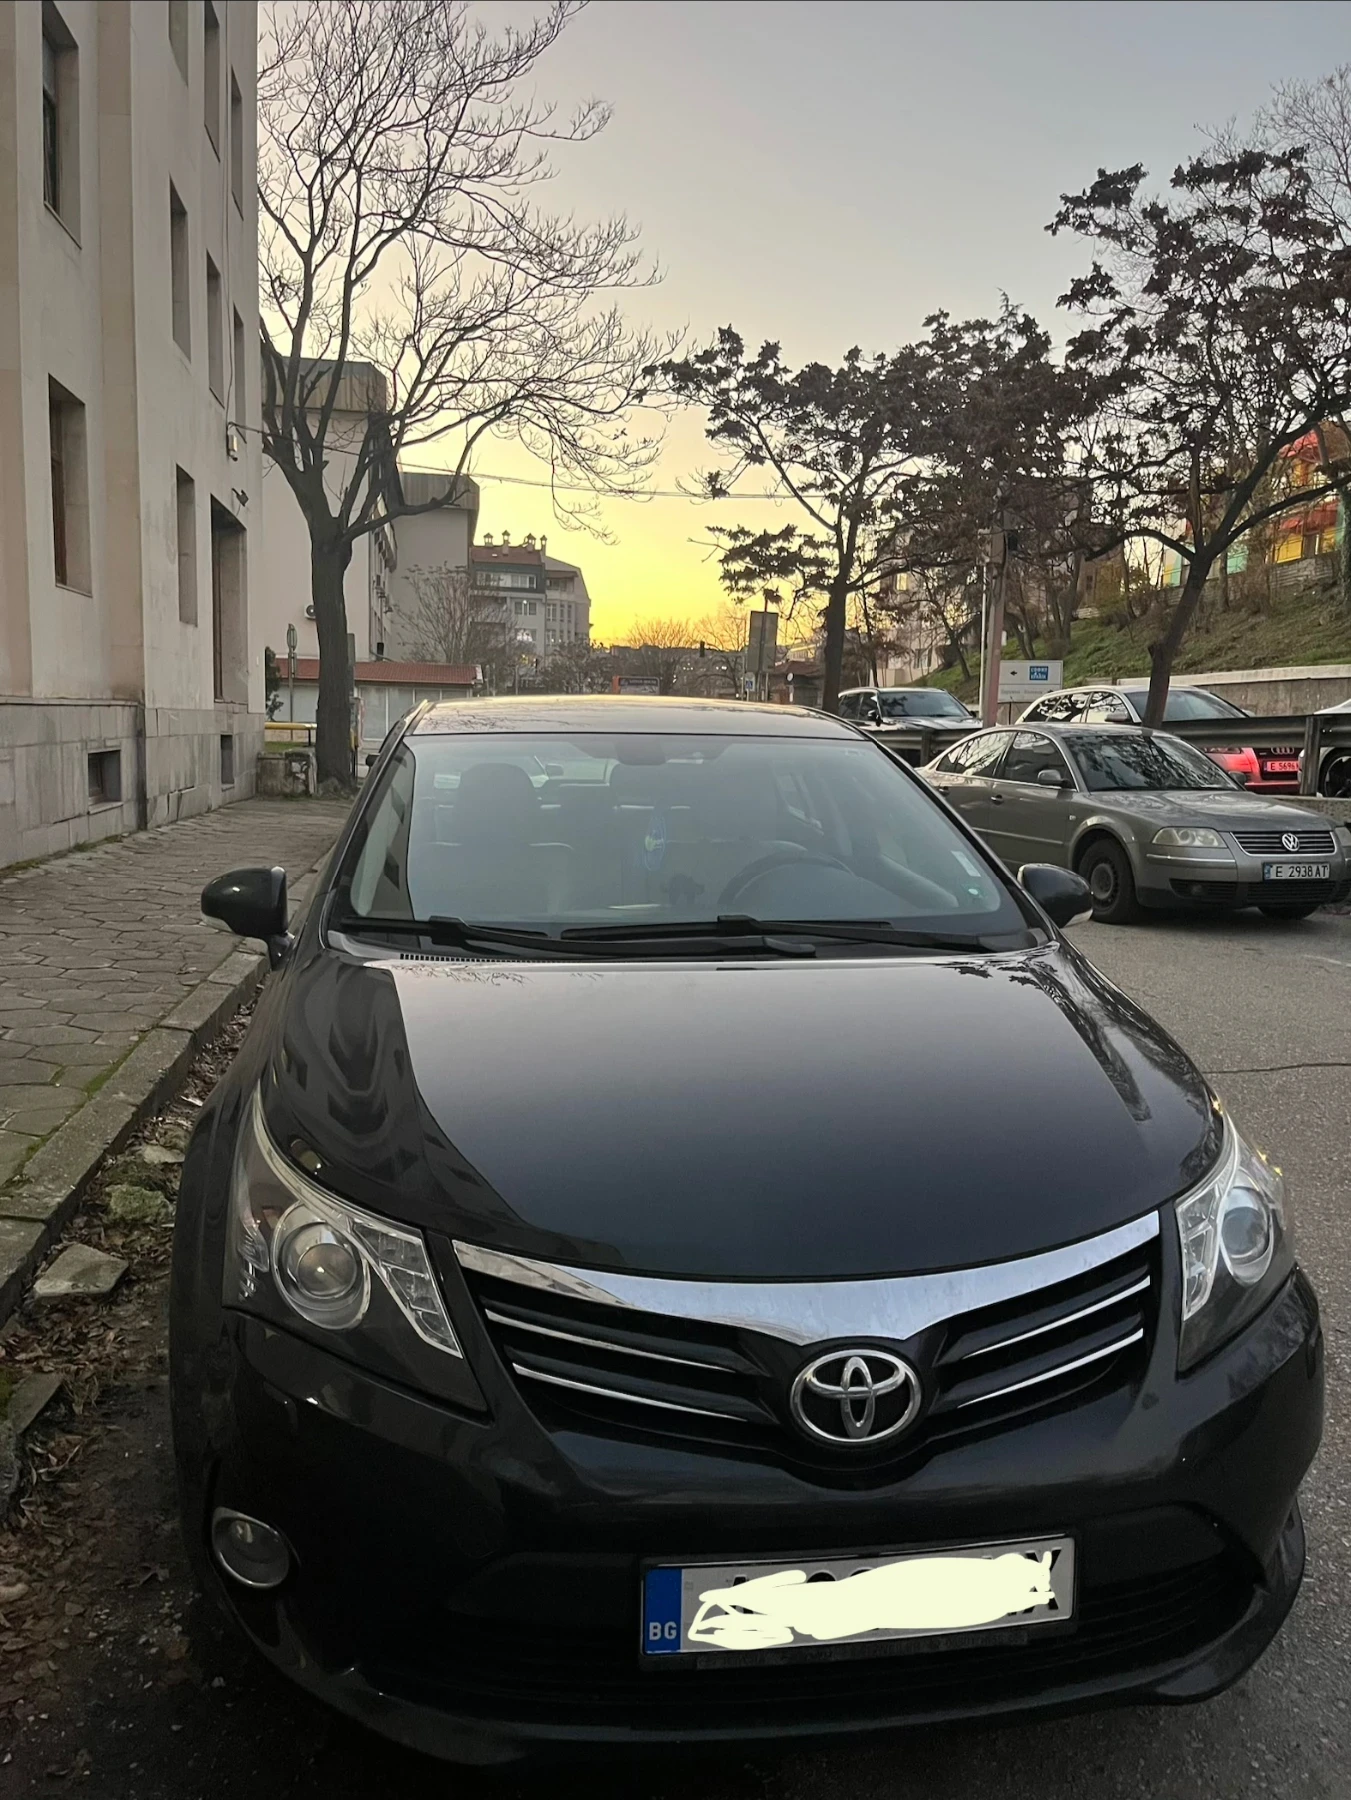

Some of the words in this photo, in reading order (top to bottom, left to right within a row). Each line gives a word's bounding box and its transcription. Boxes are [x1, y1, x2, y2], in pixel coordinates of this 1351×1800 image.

[1271, 763, 1276, 771] E
[1276, 866, 1283, 878] E
[1289, 866, 1313, 878] 2938
[649, 1621, 677, 1641] BG
